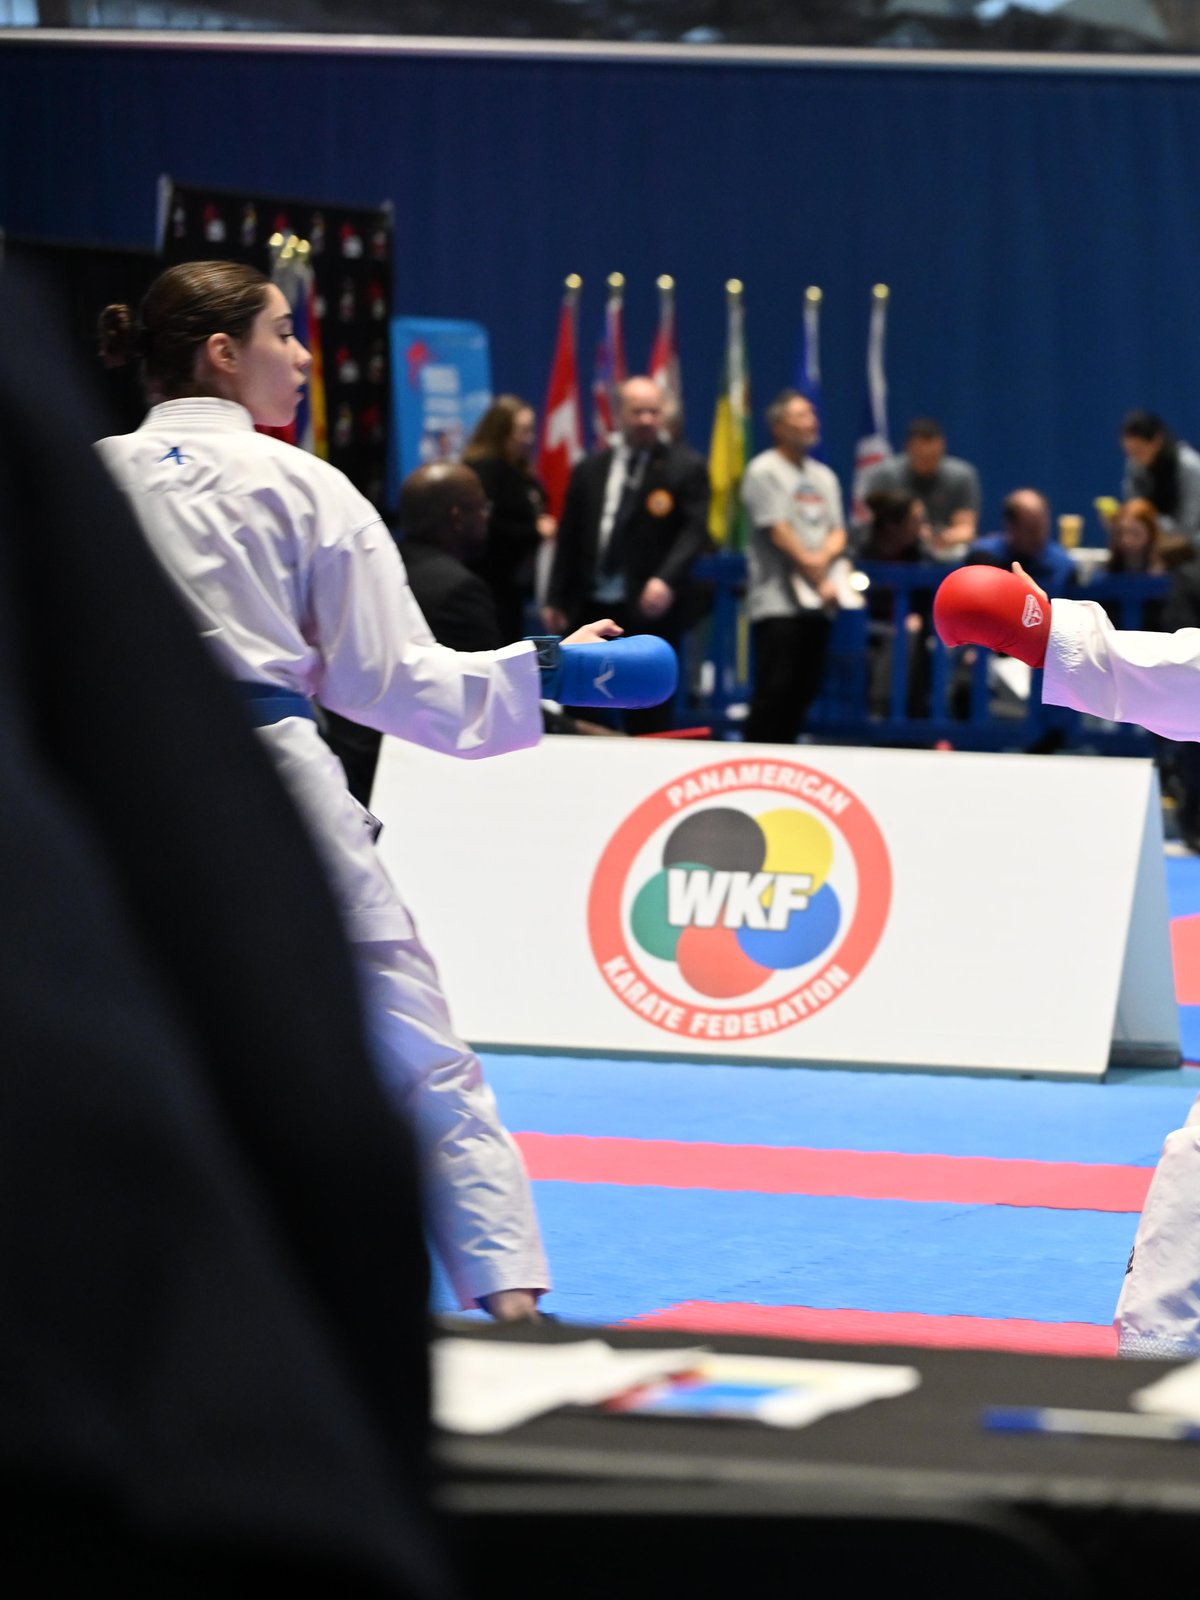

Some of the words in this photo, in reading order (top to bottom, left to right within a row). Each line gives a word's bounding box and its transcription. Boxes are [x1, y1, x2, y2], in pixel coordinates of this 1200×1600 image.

[666, 764, 851, 815] PANAMERICAN
[668, 868, 813, 931] WKF
[602, 955, 687, 1029] KARATE
[689, 964, 849, 1037] FEDERATION
